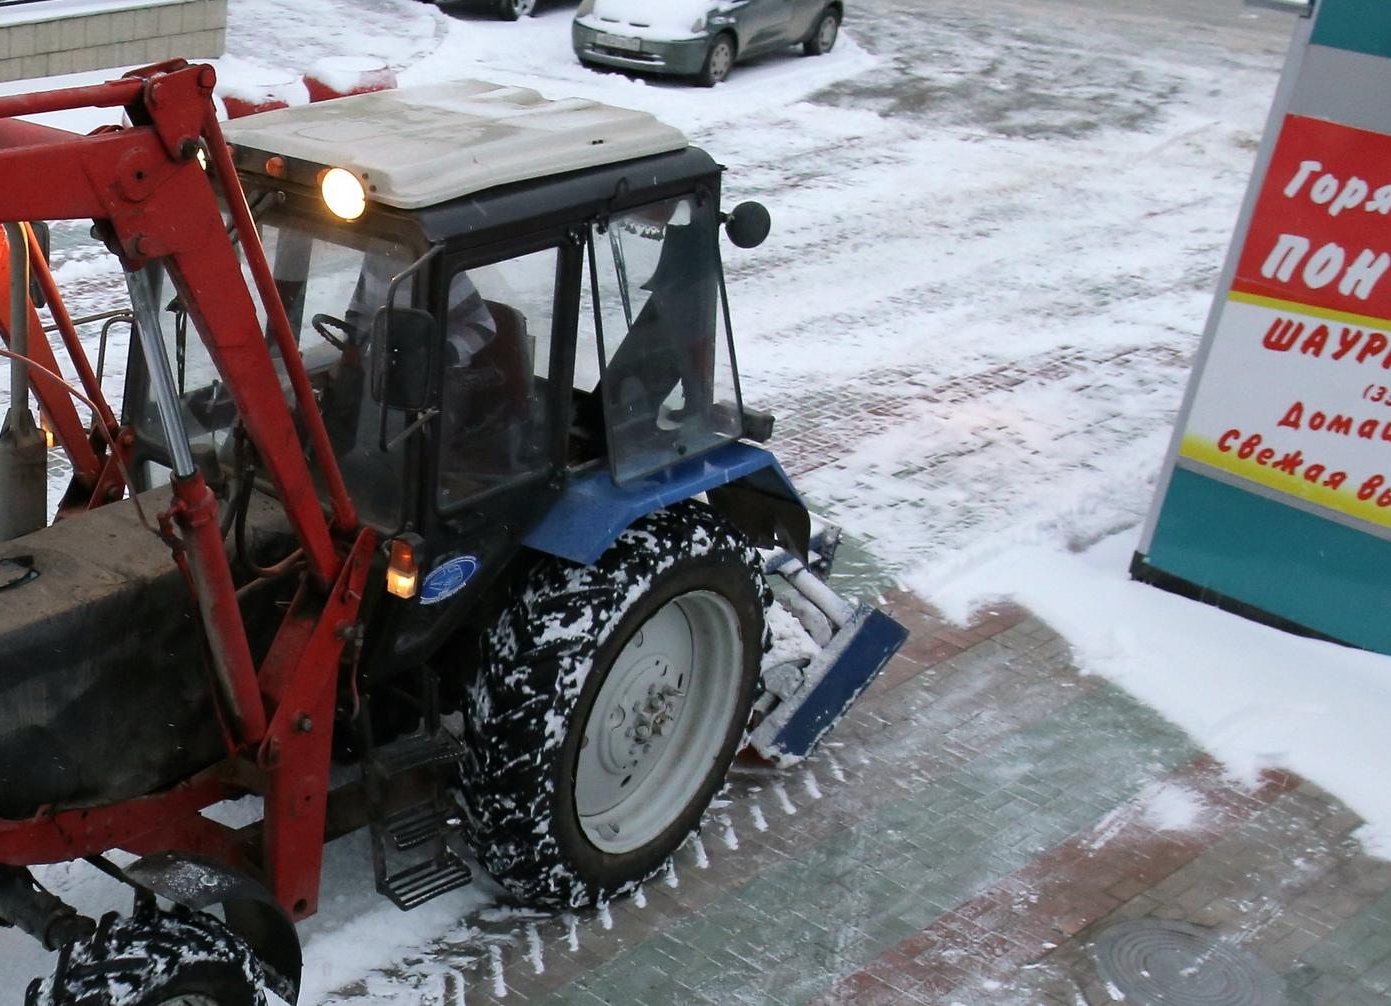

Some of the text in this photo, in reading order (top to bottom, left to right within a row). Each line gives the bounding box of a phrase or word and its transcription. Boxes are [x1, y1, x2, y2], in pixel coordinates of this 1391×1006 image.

[1283, 160, 1391, 216] Горя
[1261, 233, 1391, 300] ПОН
[1263, 317, 1391, 369] ШАУР
[1217, 429, 1347, 490] Свежая
